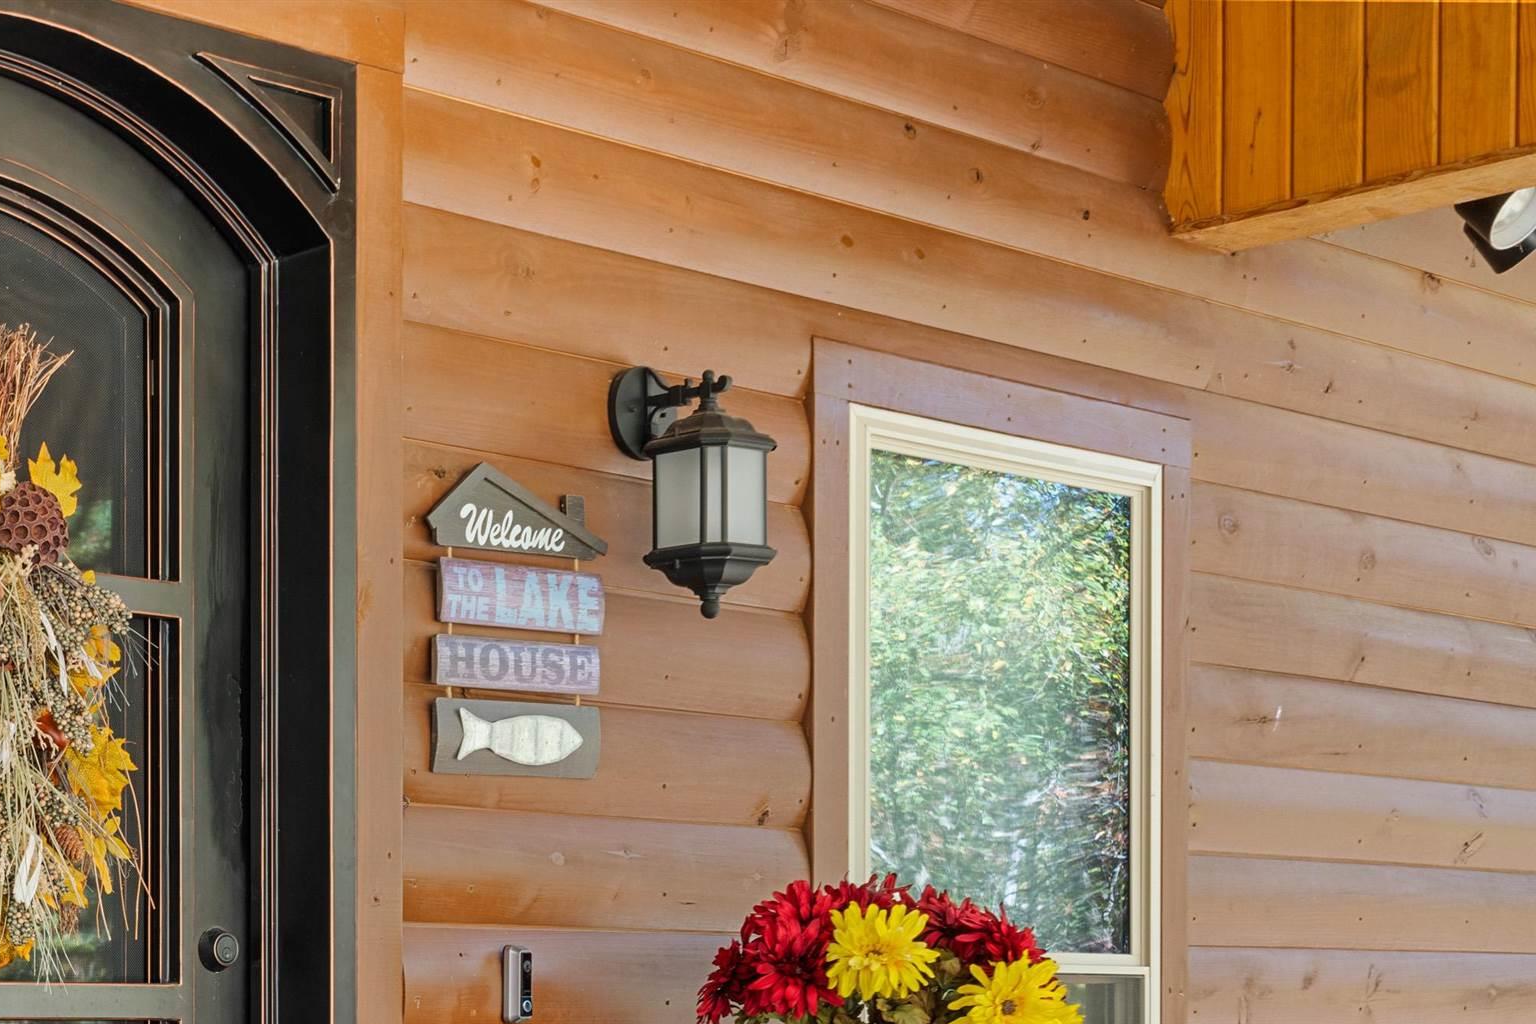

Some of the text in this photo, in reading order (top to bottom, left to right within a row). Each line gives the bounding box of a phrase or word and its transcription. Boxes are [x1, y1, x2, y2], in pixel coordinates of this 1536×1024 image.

[460, 503, 565, 552] Welcome
[452, 566, 484, 592] TO
[494, 567, 600, 632] LAKE
[447, 593, 489, 620] THE
[445, 641, 594, 687] HOUSE
